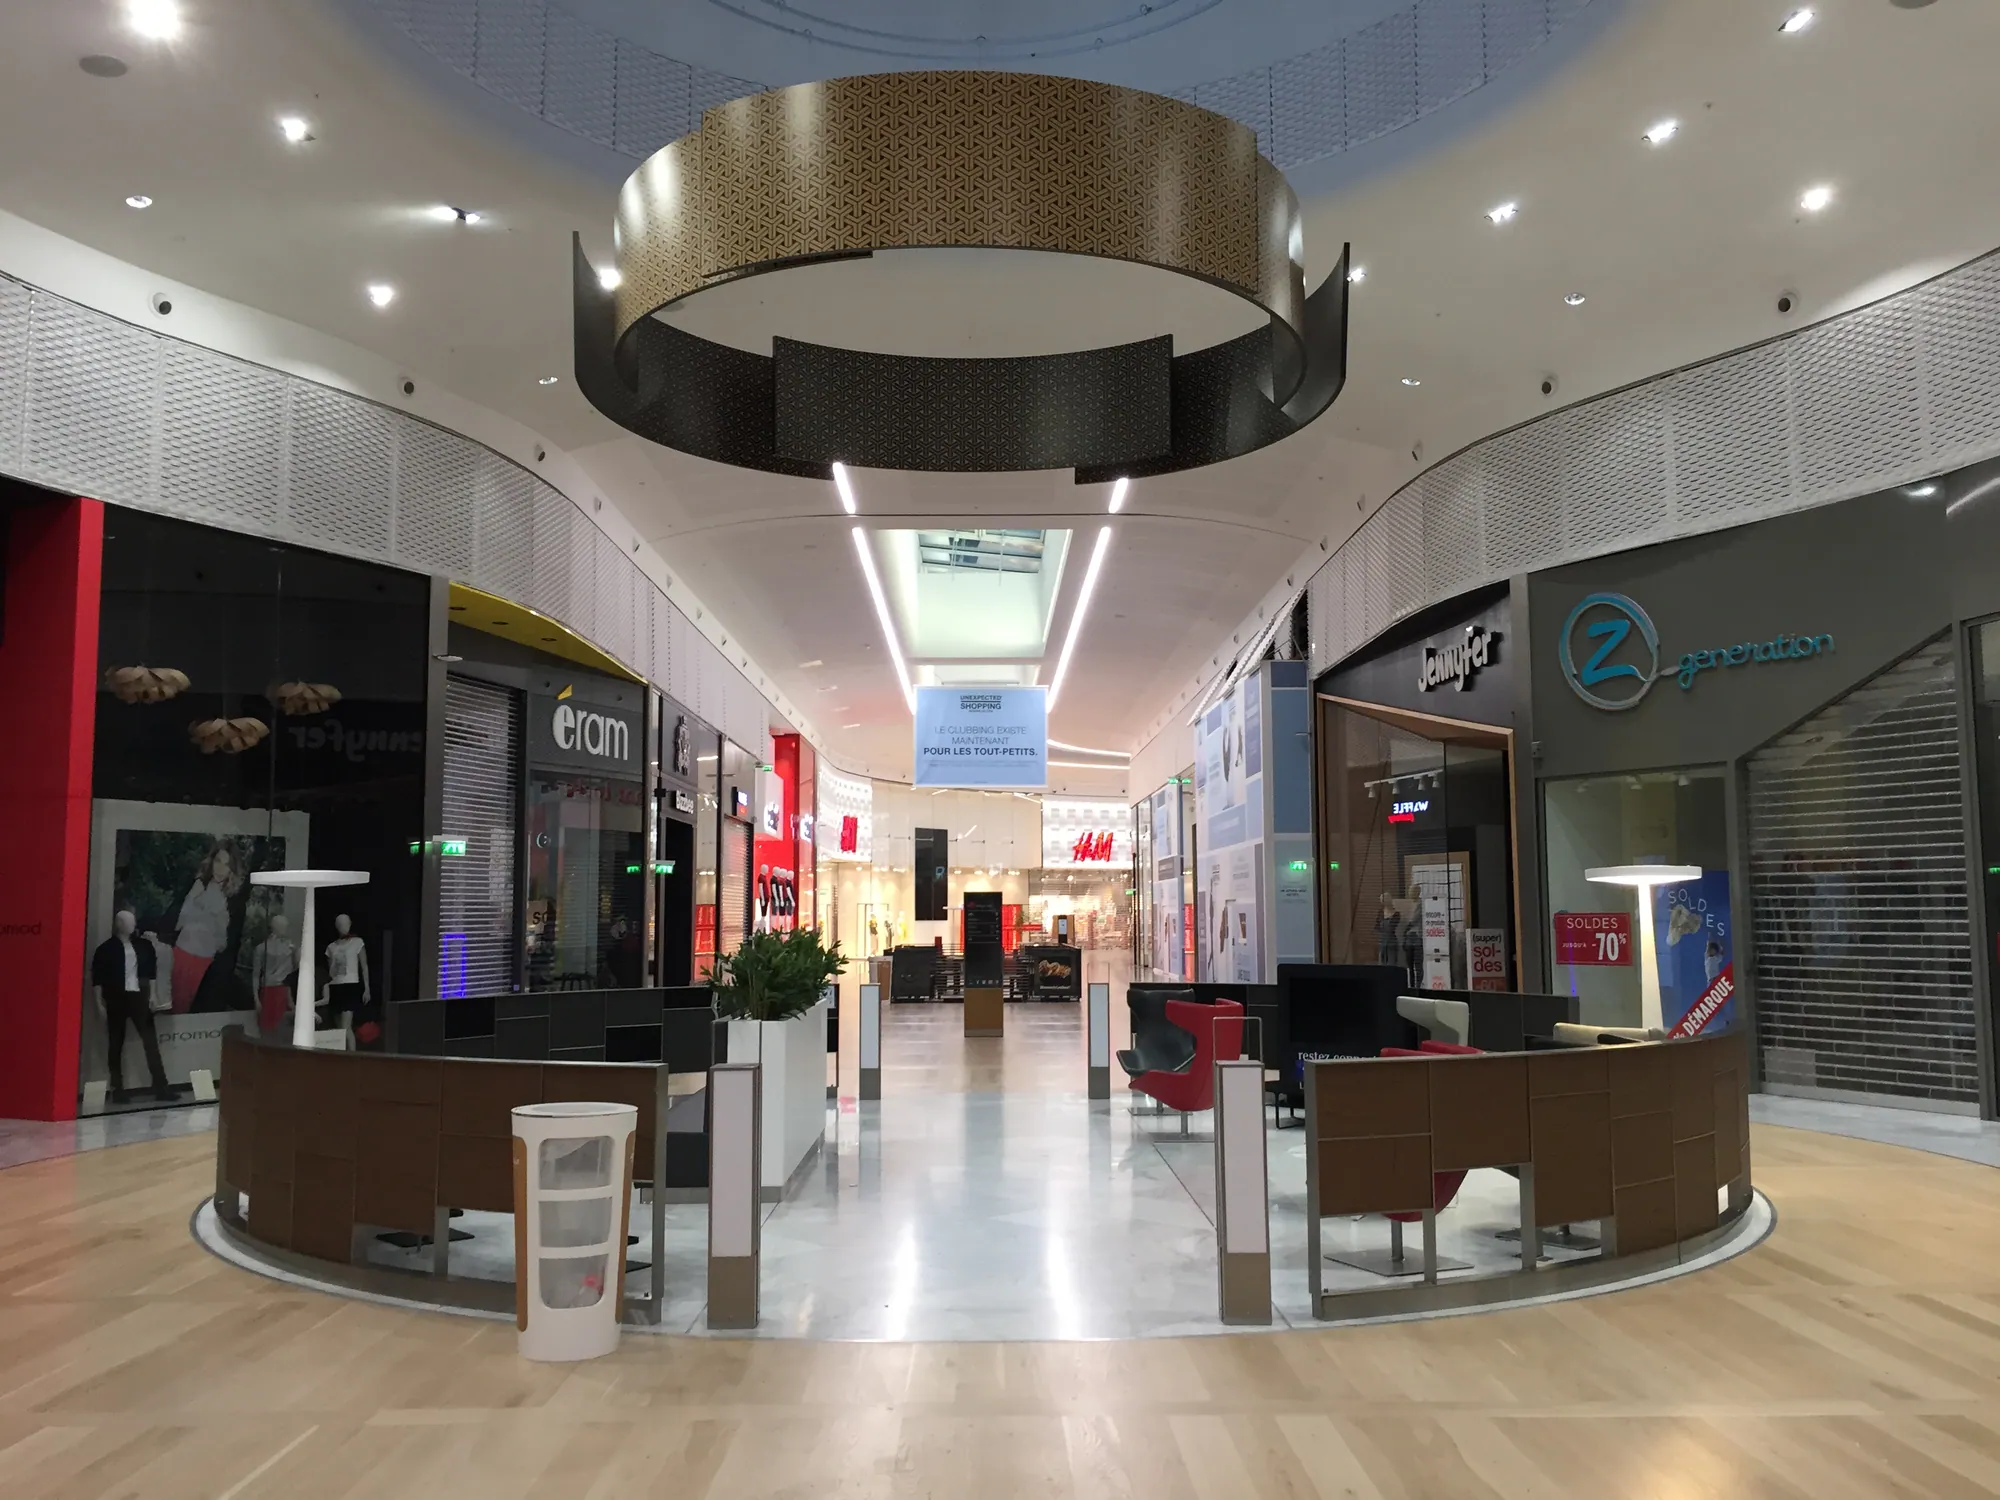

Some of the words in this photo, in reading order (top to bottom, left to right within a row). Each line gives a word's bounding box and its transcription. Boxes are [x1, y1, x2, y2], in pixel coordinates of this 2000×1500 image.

[1418, 625, 1492, 693] Jennyfer
[1677, 632, 1836, 690] generation
[960, 702, 1002, 710] SHOPPING
[552, 684, 629, 761] éram
[934, 726, 946, 734] LE
[947, 726, 994, 735] CLUBBING
[996, 726, 1027, 735] EXISTE
[951, 736, 1009, 745] MAINTENANT
[923, 747, 951, 756] POUR
[953, 747, 972, 756] LES
[974, 747, 1038, 756] TOUT-PETITS.
[1566, 917, 1619, 929] SOLDES
[1472, 933, 1502, 943] (super)
[1472, 944, 1502, 958] sol-
[1473, 958, 1503, 973] des
[1682, 975, 1735, 1037] DÉMARQUE
